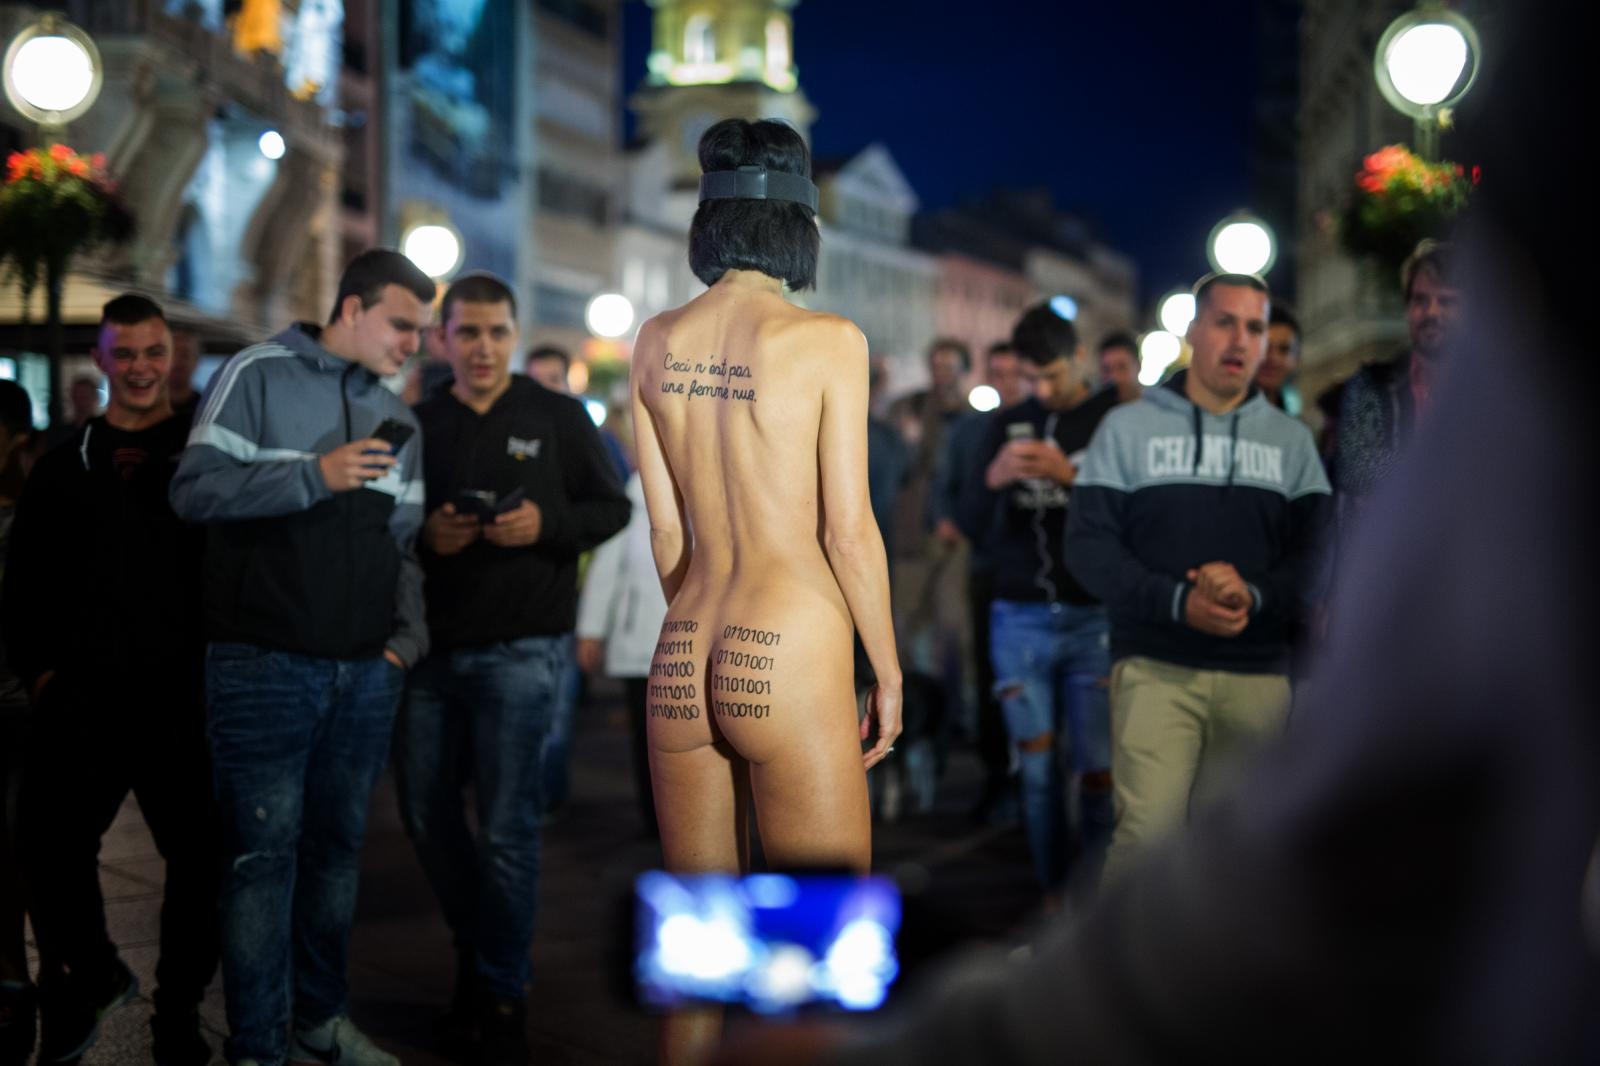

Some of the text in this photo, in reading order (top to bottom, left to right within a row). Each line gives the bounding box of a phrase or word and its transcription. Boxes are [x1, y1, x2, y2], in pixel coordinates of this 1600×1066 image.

[664, 353, 691, 373] Ceci
[728, 365, 752, 384] pas
[661, 379, 757, 402] une femme nue.
[724, 625, 780, 646] 01101001
[650, 661, 694, 678] 01110100
[717, 649, 774, 670] 01101001
[650, 684, 696, 700] 01111010
[713, 674, 771, 694] 01101001
[650, 704, 700, 720] 01100100
[714, 700, 770, 719] 01100101
